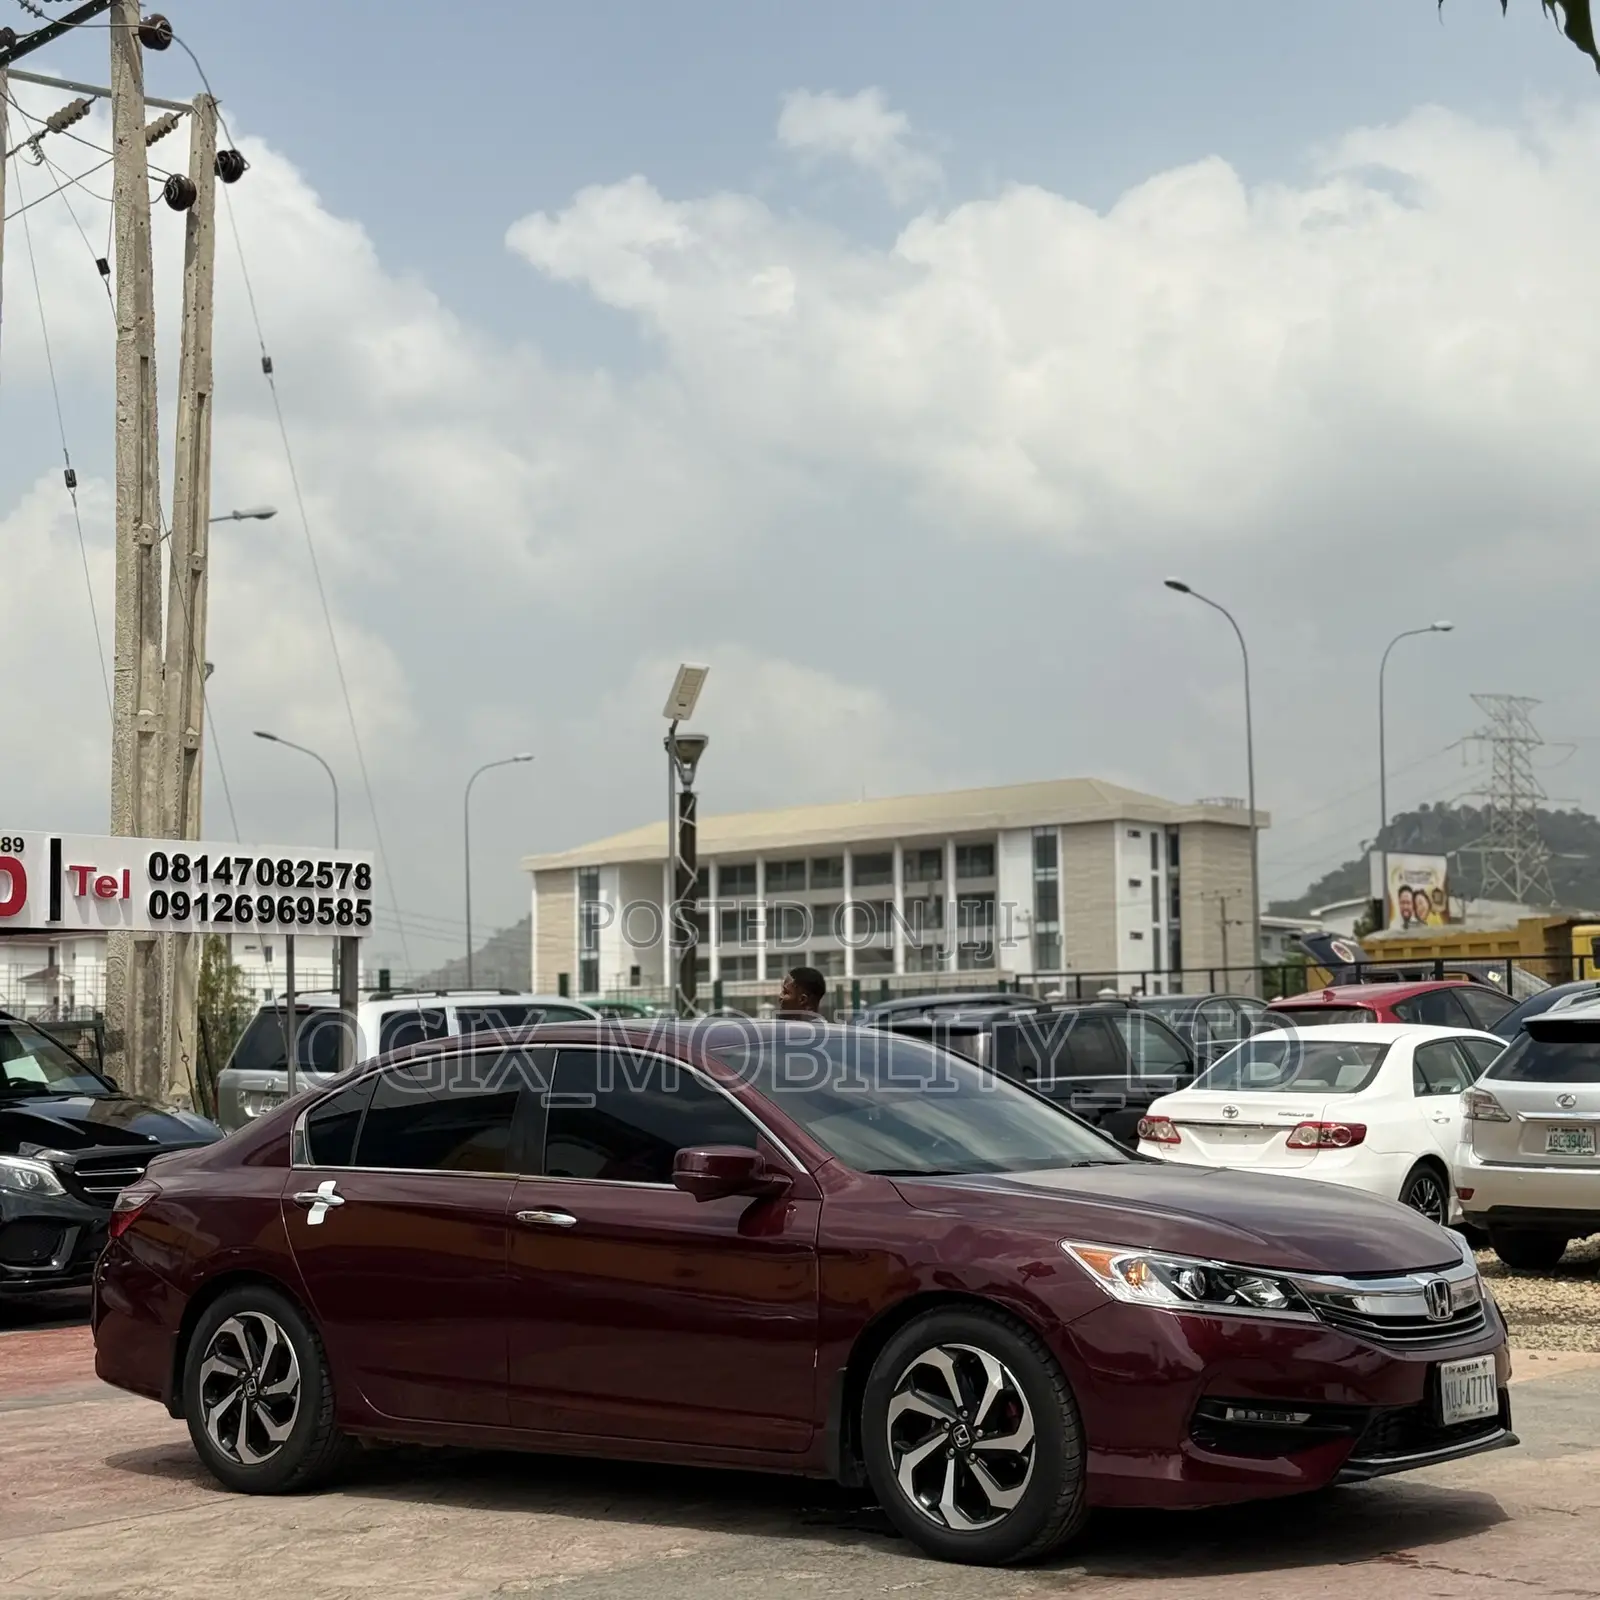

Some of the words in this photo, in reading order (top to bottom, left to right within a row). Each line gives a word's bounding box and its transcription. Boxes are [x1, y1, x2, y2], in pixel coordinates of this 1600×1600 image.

[69, 865, 131, 899] Tel
[149, 851, 372, 891] 08147082578
[149, 890, 372, 926] 09126969585
